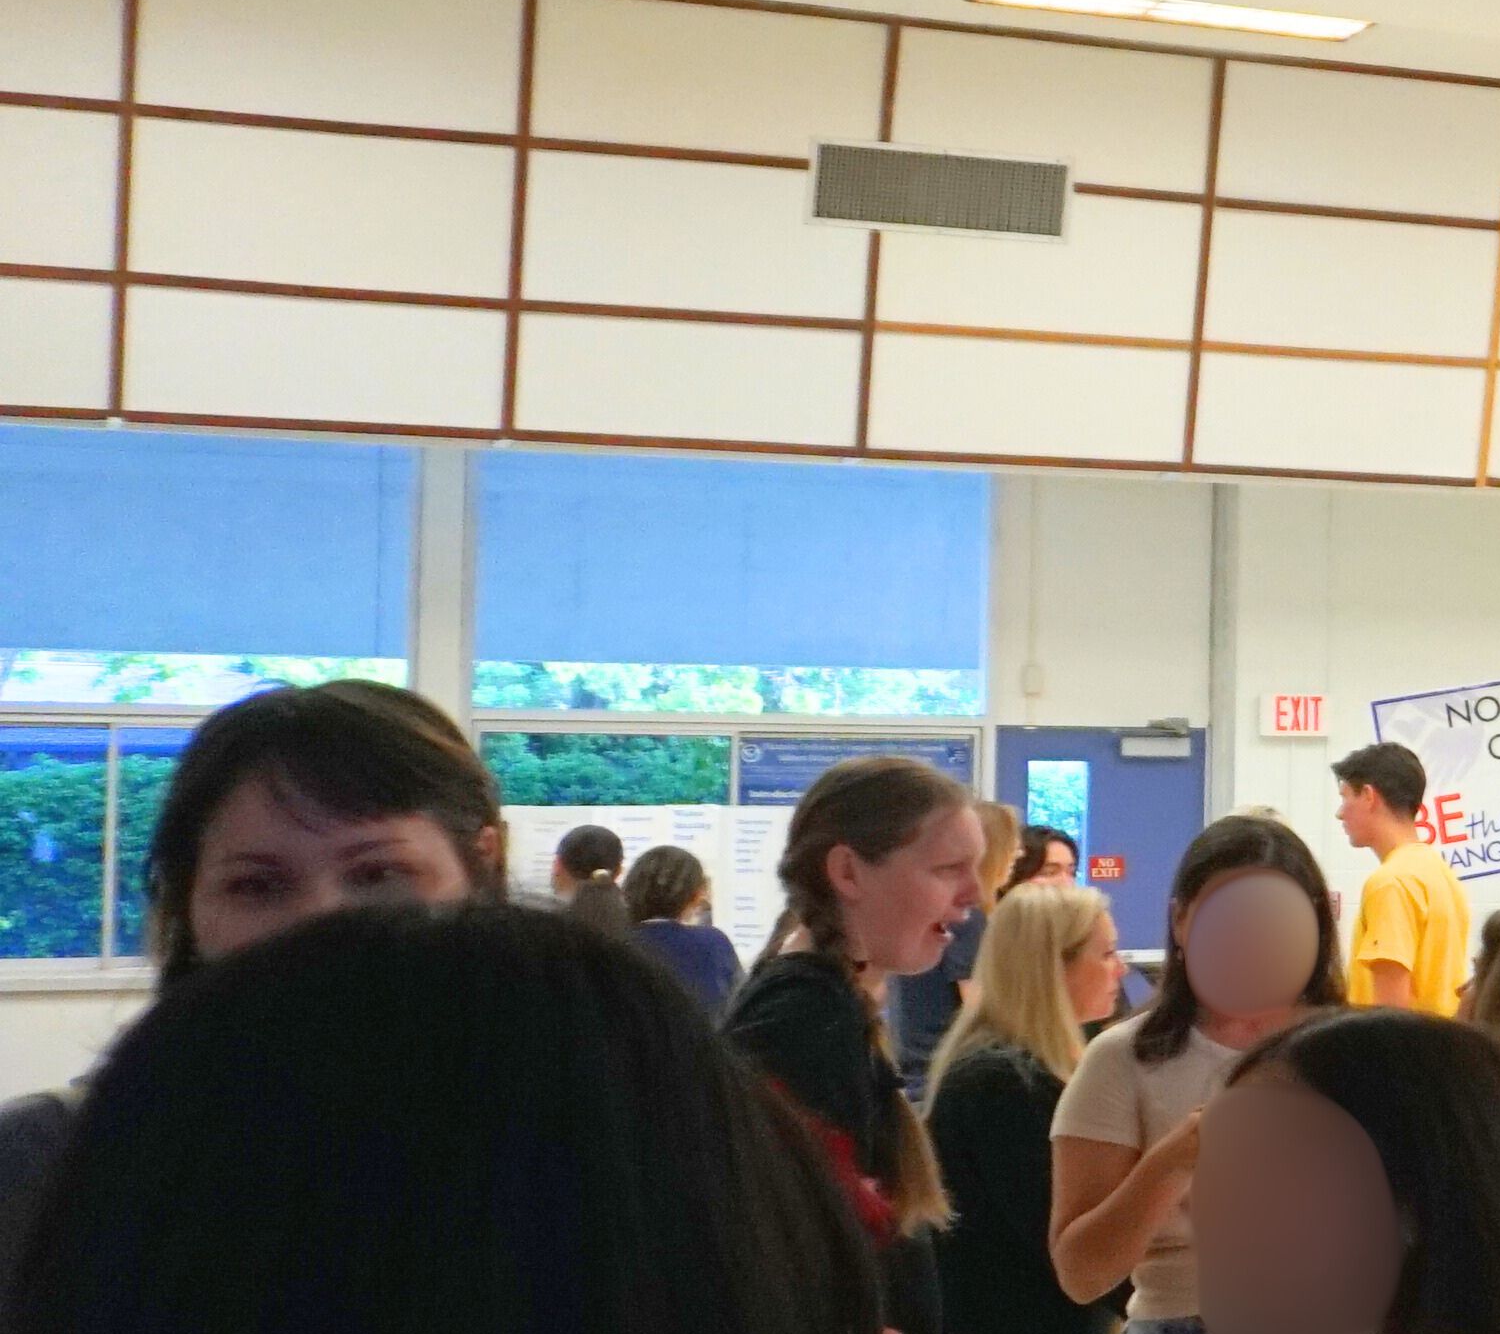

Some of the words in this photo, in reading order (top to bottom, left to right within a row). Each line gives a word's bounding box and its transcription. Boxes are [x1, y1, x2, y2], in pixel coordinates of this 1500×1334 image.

[1275, 696, 1323, 732] EXIT
[1413, 792, 1468, 845] BE
[1091, 867, 1121, 878] EXIT
[1097, 857, 1116, 868] NO
